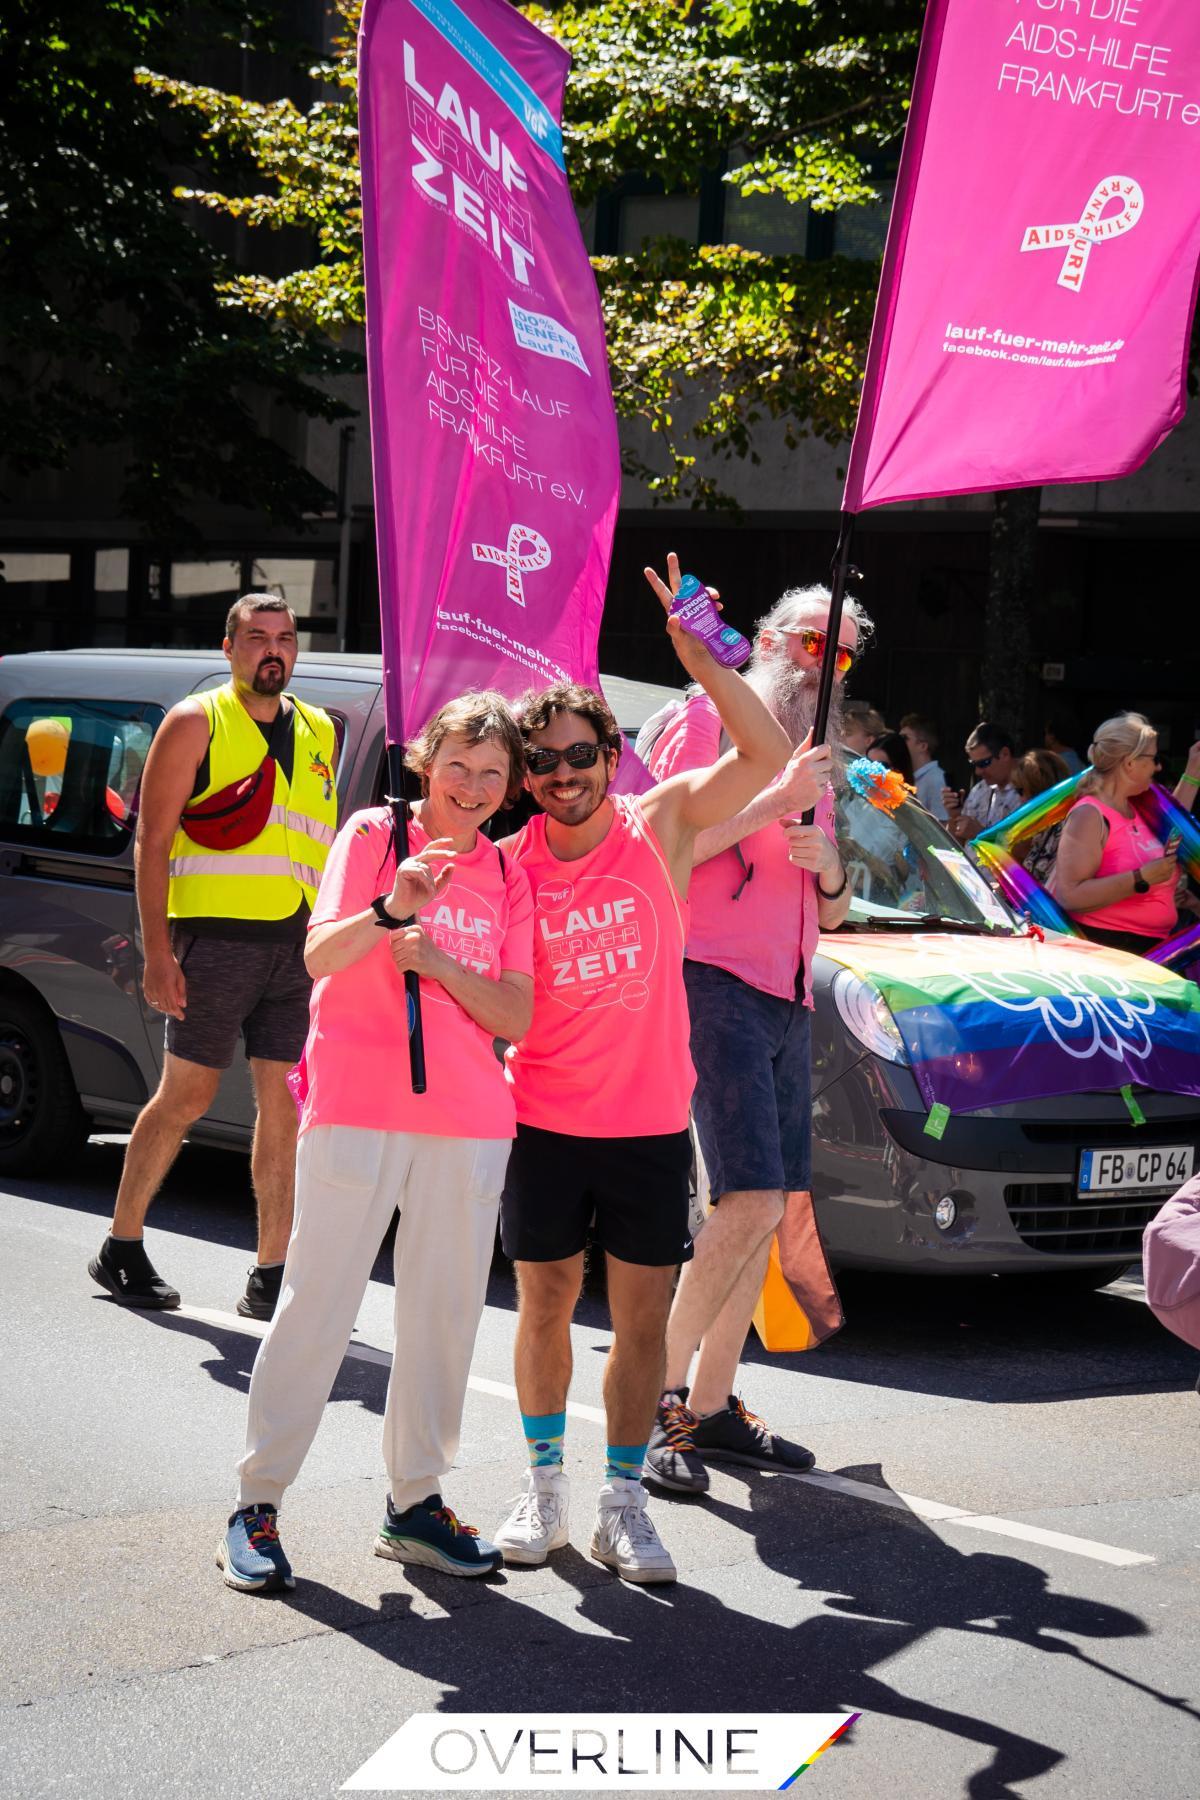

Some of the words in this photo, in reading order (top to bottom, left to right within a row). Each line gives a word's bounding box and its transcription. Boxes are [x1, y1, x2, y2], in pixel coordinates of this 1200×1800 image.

[1090, 0, 1142, 26] DIE
[1005, 20, 1172, 76] AIDS-HILFE
[403, 39, 527, 193] LAUF
[997, 63, 1183, 121] FRANKFURT
[412, 99, 460, 169] FÜR
[465, 151, 527, 241] MEHR
[411, 133, 535, 287] ZEIT
[1027, 229, 1076, 246] AIDS
[1094, 201, 1139, 237] HILFE
[512, 307, 554, 331] 100%
[517, 332, 554, 353] Lauf
[418, 306, 571, 418] BENEFIZ-LAUF
[421, 337, 469, 380] FÜR
[474, 367, 500, 412] DIE
[426, 370, 528, 461] AIDS-HILFE
[428, 399, 548, 493] FRANKFURT
[550, 483, 587, 509] e.V.
[475, 545, 509, 564] AIDS
[540, 897, 636, 941] LAUF
[551, 939, 583, 959] FÜR
[586, 926, 638, 951] MEHR
[552, 946, 642, 987] ZEIT
[1098, 1154, 1124, 1184] FB
[1137, 1152, 1161, 1182] CP
[1165, 1151, 1187, 1181] 64
